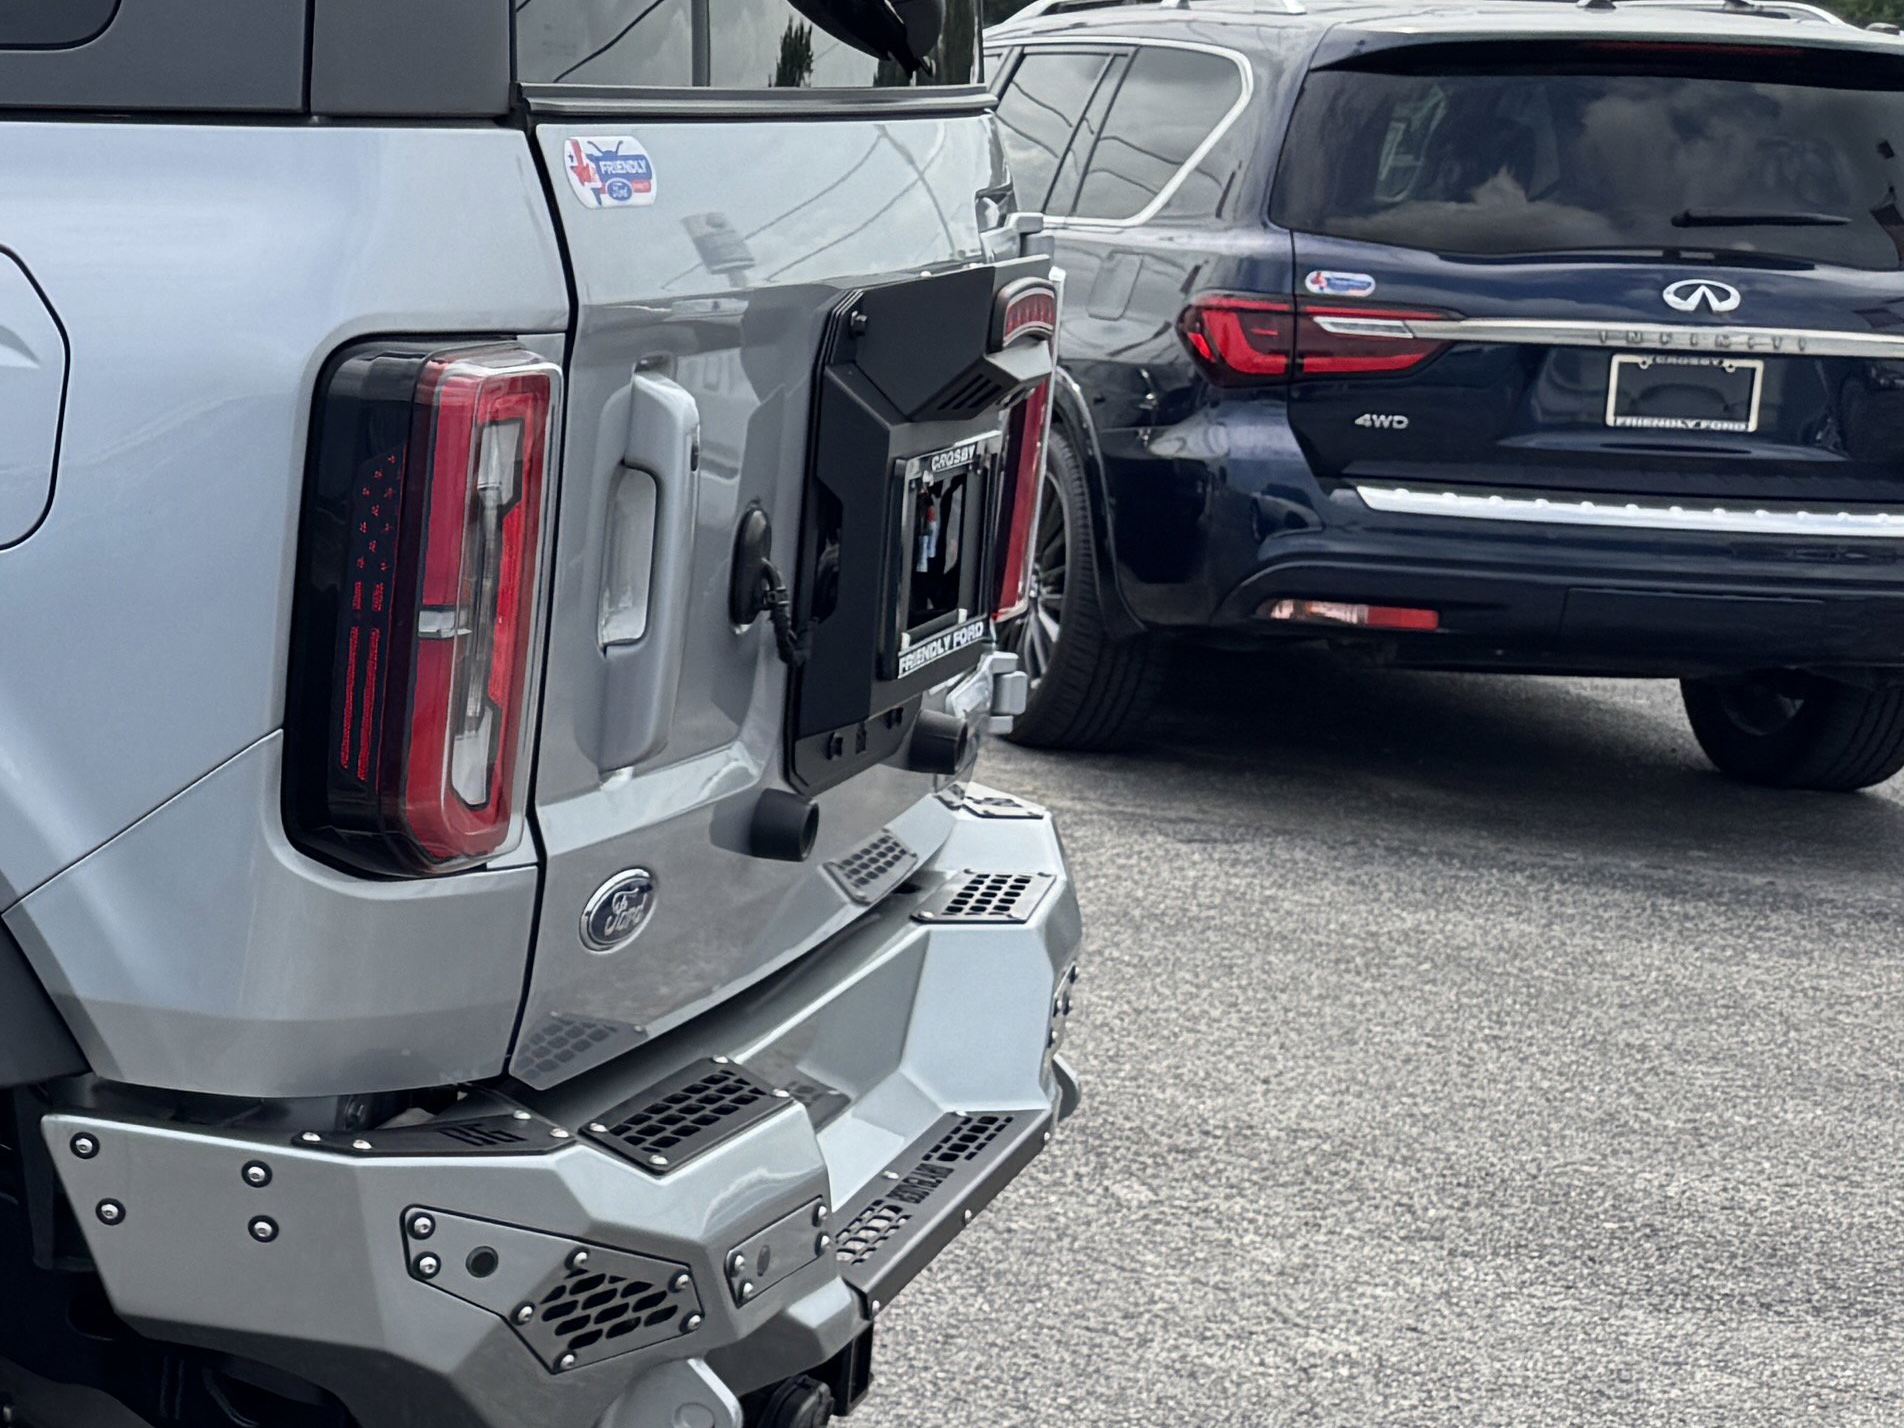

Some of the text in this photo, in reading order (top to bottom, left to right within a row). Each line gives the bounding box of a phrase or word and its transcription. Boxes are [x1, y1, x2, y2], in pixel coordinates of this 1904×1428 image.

[599, 160, 647, 174] FRIENDLY
[1354, 414, 1409, 429] 4WD
[1616, 417, 1748, 431] FRIENDLY FORD
[931, 444, 976, 472] CROSBY
[898, 622, 985, 673] FRIENDLY FORD
[604, 887, 649, 937] Ford
